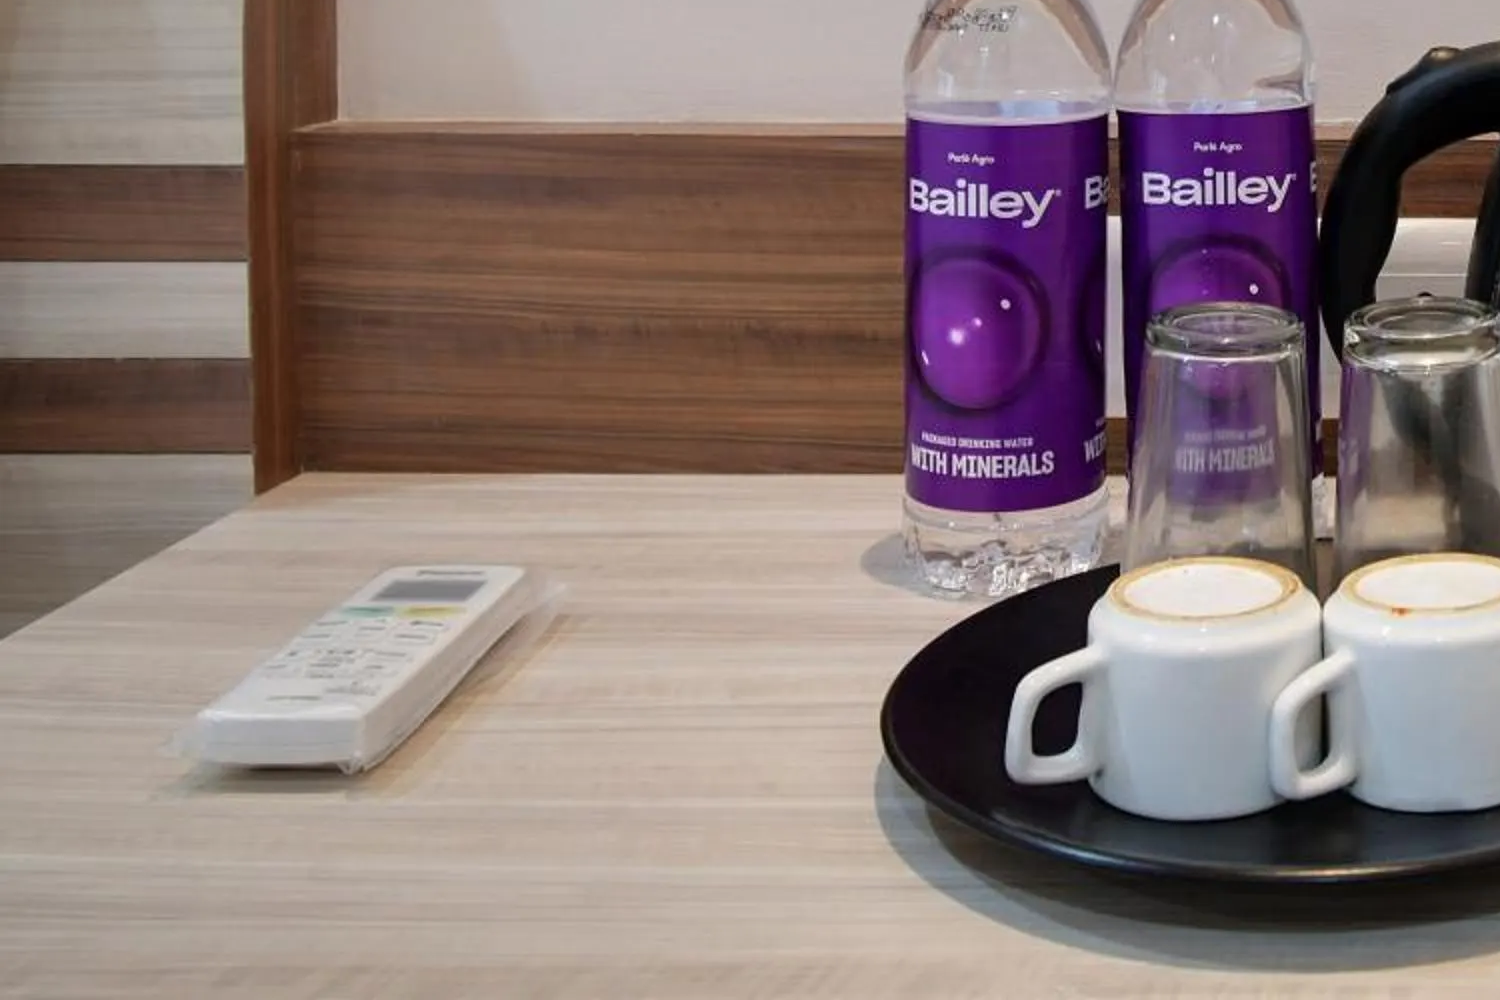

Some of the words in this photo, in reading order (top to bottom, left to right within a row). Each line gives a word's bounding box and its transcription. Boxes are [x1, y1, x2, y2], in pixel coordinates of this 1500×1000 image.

[971, 153, 995, 166] Agro
[1219, 141, 1243, 154] Agro
[909, 177, 1055, 228] Bailley
[1142, 167, 1293, 213] Bailley
[958, 437, 1002, 449] DRINKING
[1003, 436, 1034, 449] WATER
[911, 442, 947, 475] WITH
[951, 450, 1055, 479] MINERALS
